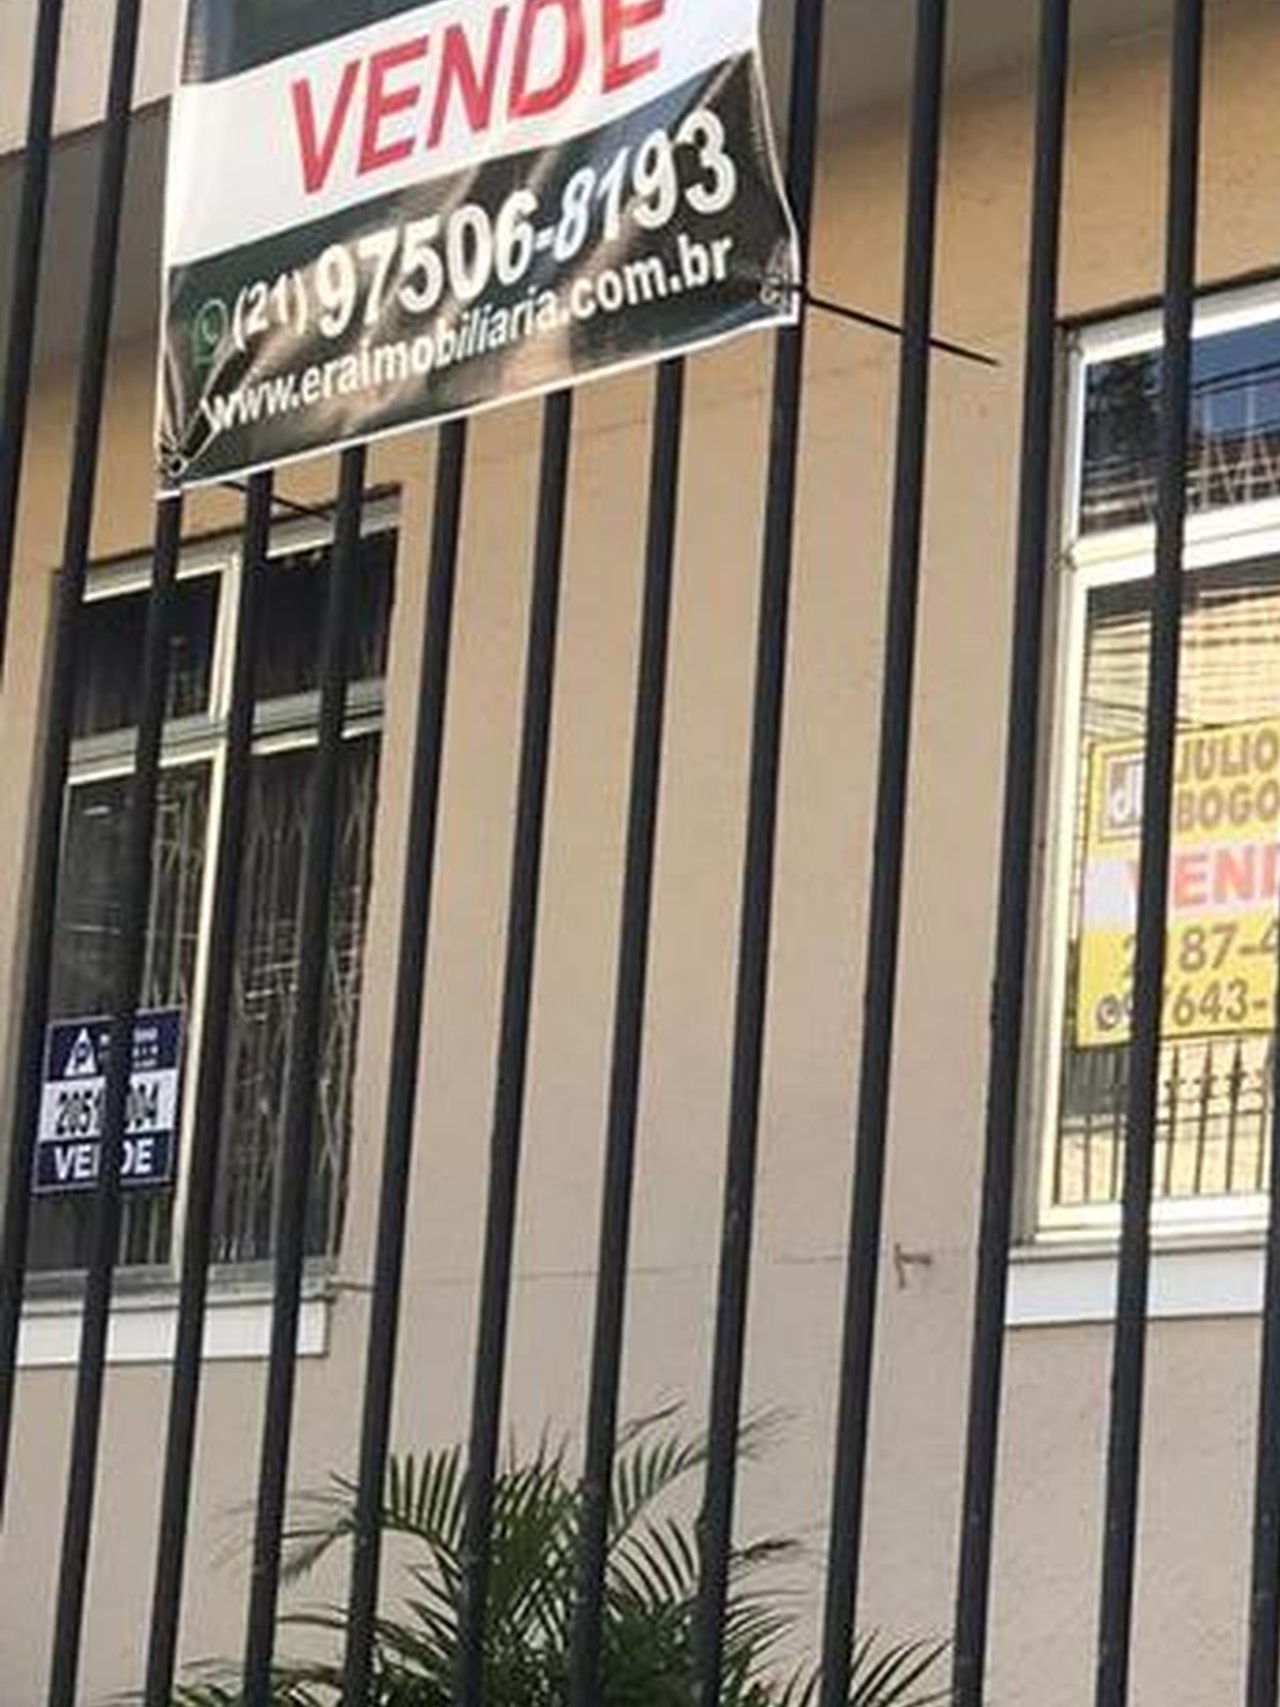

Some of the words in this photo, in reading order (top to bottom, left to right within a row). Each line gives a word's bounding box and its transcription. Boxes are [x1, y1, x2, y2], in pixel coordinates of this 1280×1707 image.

[231, 268, 308, 351] (21)
[317, 109, 737, 340] 97506-8193
[201, 233, 734, 433] www.eraimobiliaria.com.br
[1176, 728, 1280, 783] JULIO
[53, 1137, 156, 1180] VEDE
